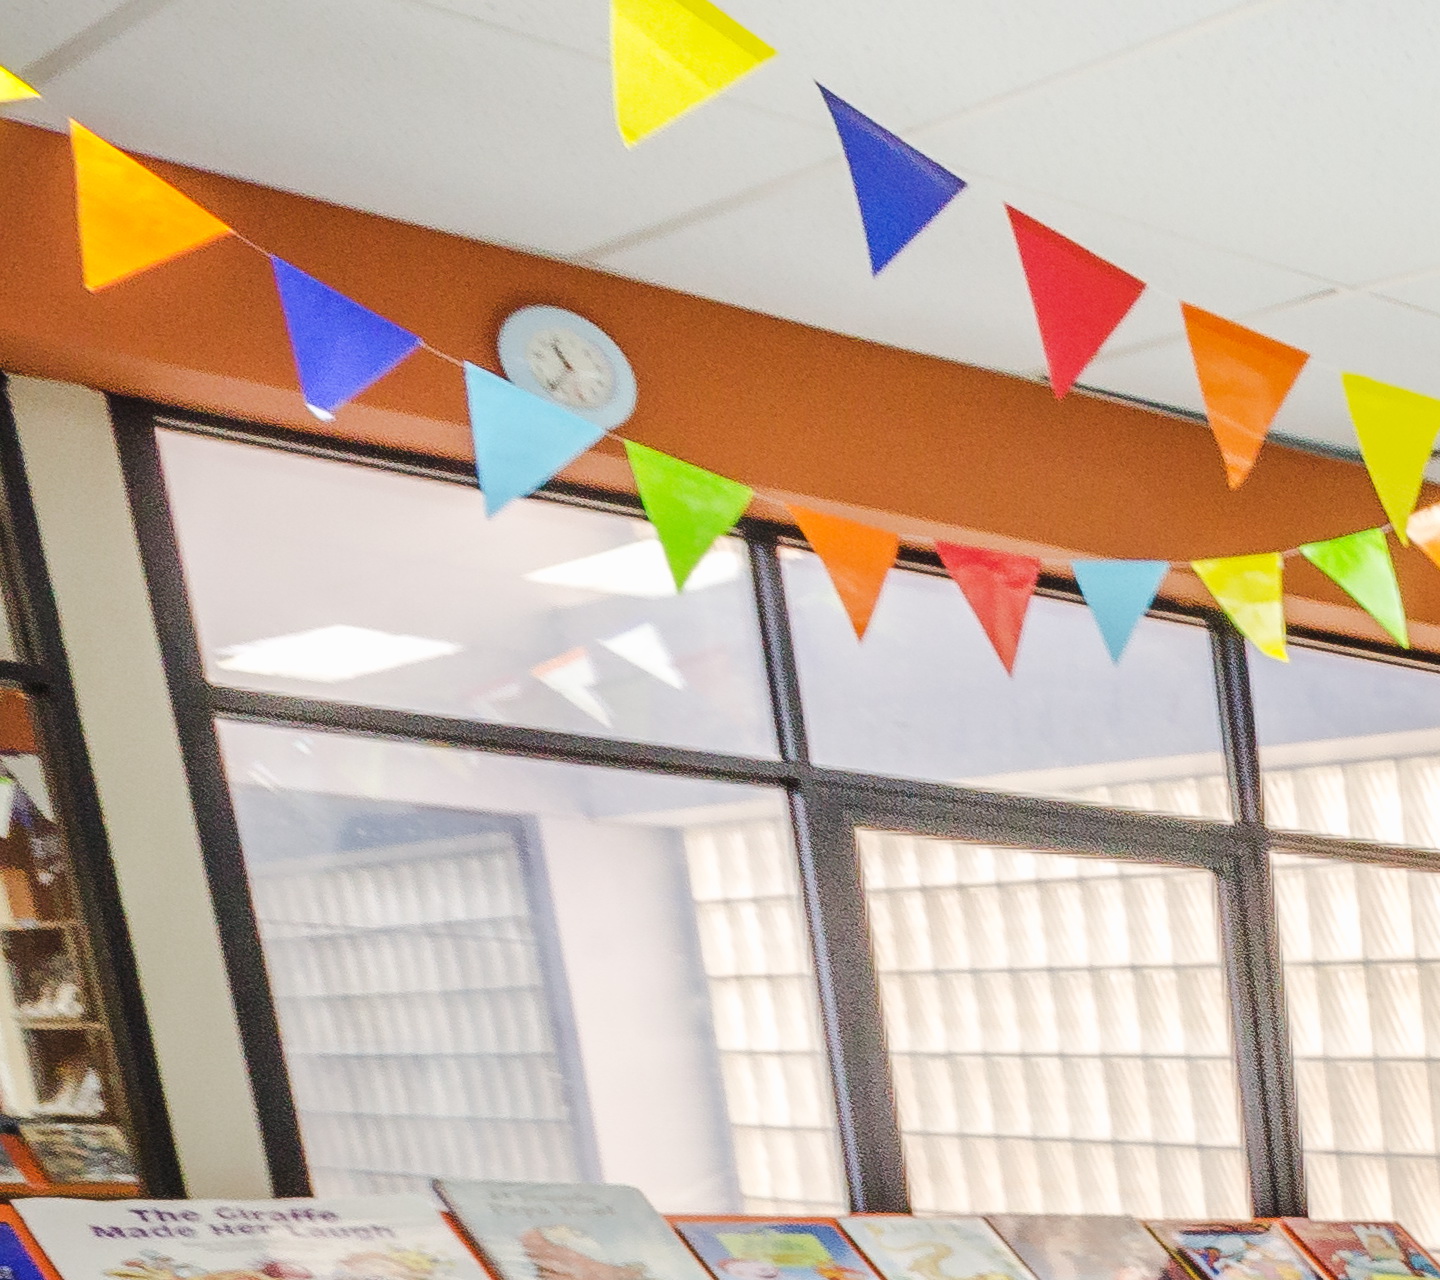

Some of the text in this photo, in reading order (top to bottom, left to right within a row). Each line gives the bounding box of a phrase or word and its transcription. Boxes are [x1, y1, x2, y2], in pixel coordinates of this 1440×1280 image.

[129, 1206, 341, 1224] The Giraffe
[89, 1223, 197, 1240] Made
[287, 1222, 398, 1241] Laugh
